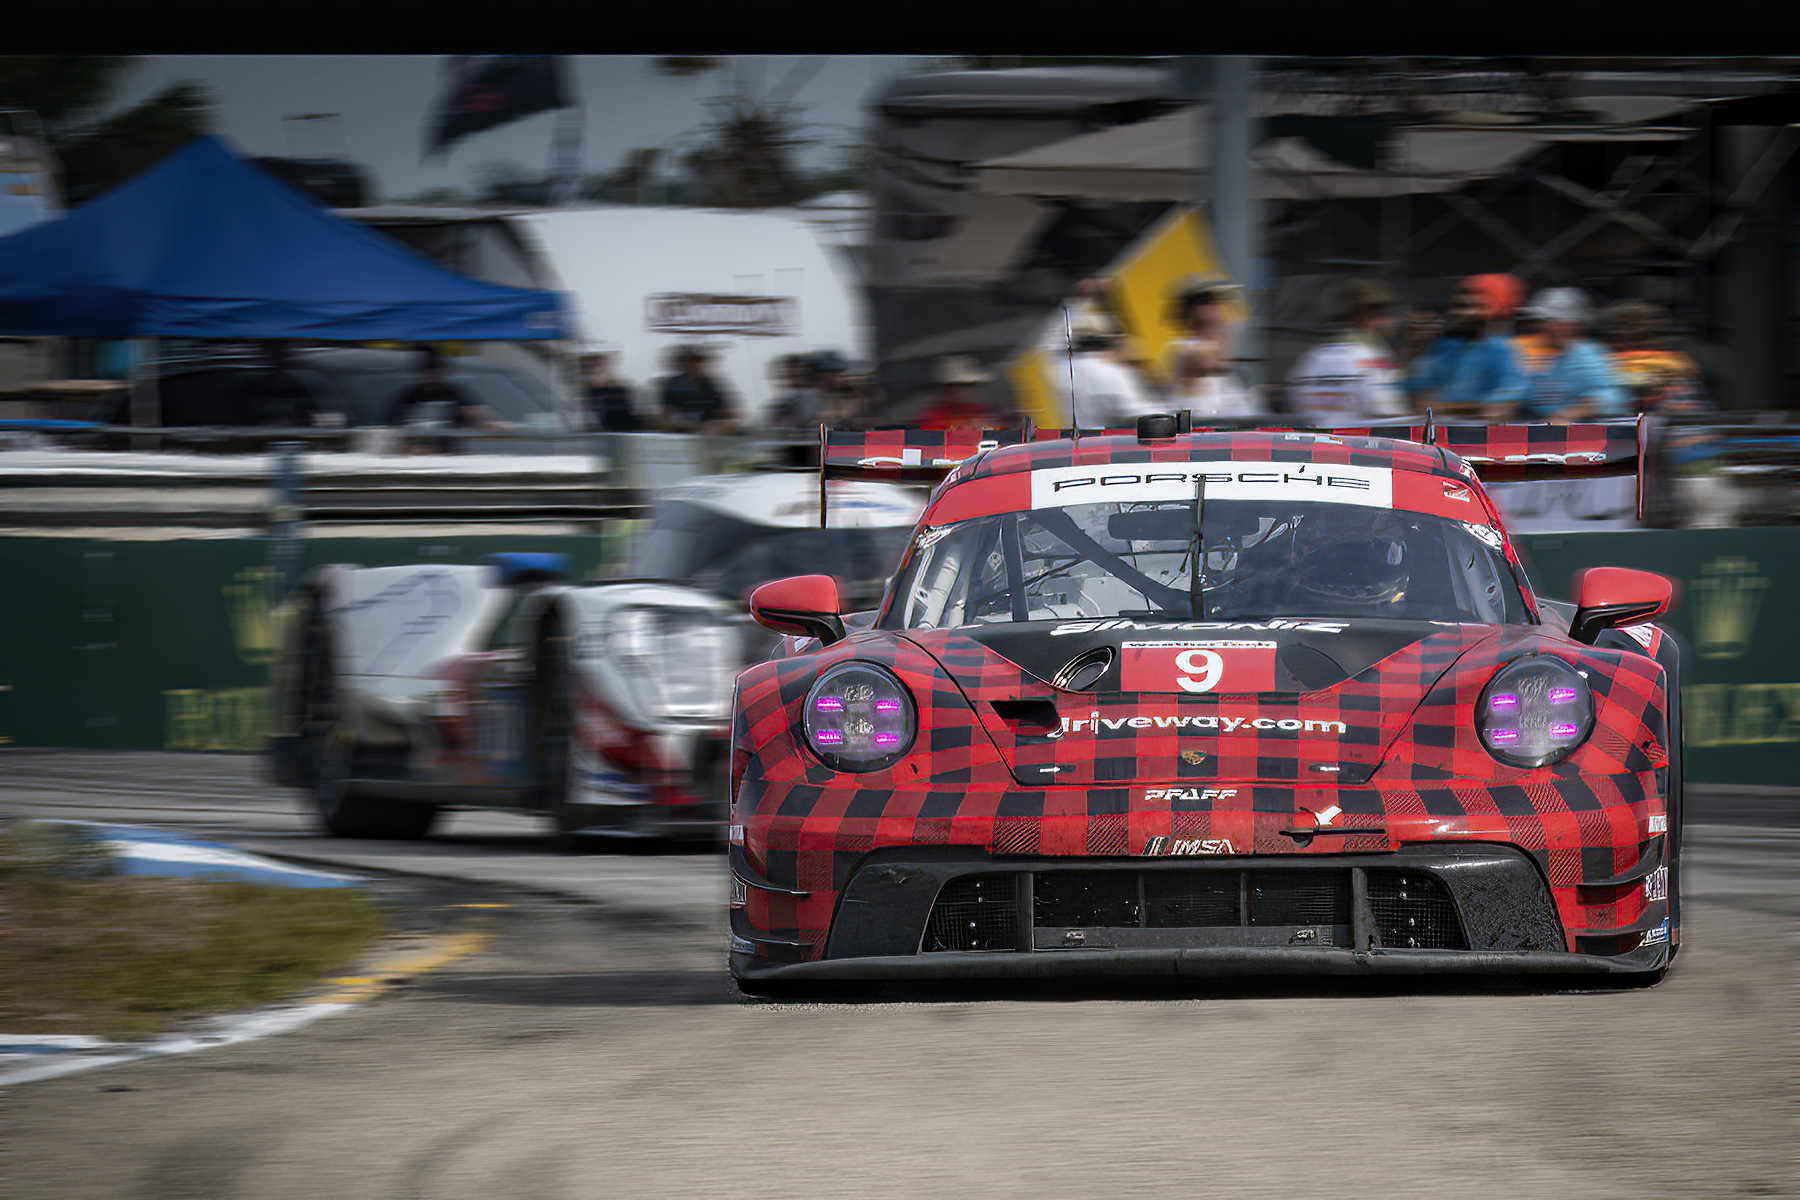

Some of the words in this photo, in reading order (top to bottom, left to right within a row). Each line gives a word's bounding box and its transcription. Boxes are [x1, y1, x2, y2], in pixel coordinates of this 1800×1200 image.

[1053, 472, 1370, 492] PORSCHE
[1175, 648, 1223, 693] 9
[1144, 788, 1238, 801] PFAFF
[1170, 838, 1236, 856] IMSA
